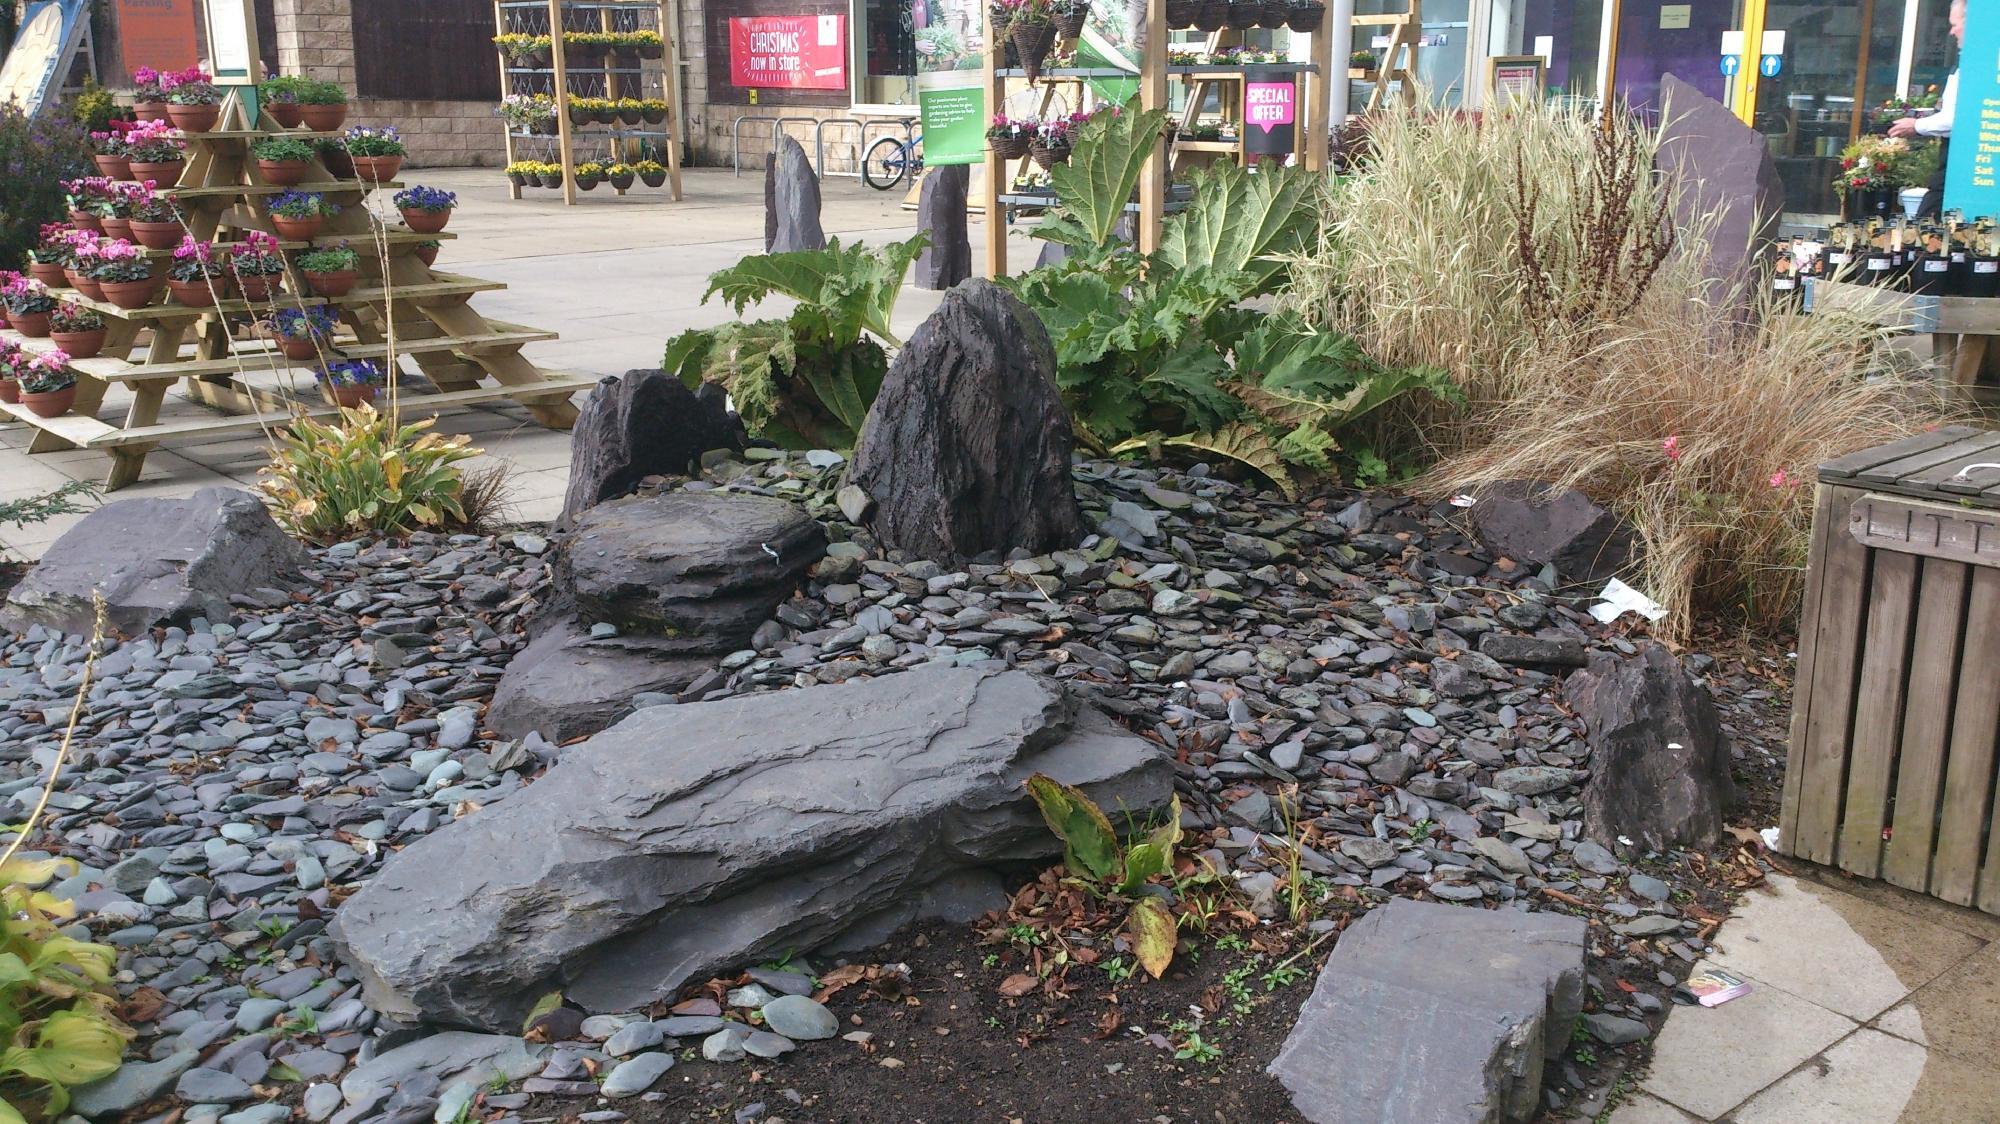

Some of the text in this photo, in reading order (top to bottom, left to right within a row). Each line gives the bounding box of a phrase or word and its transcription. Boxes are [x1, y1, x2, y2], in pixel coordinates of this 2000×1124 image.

[750, 31, 799, 53] CHRISTMAS
[750, 53, 800, 71] now in store
[1248, 87, 1291, 104] SPECIAL
[1252, 104, 1284, 121] OFFER
[1975, 154, 1991, 163] Fri
[1974, 166, 1993, 175] Sat
[1973, 176, 1995, 186] Sun
